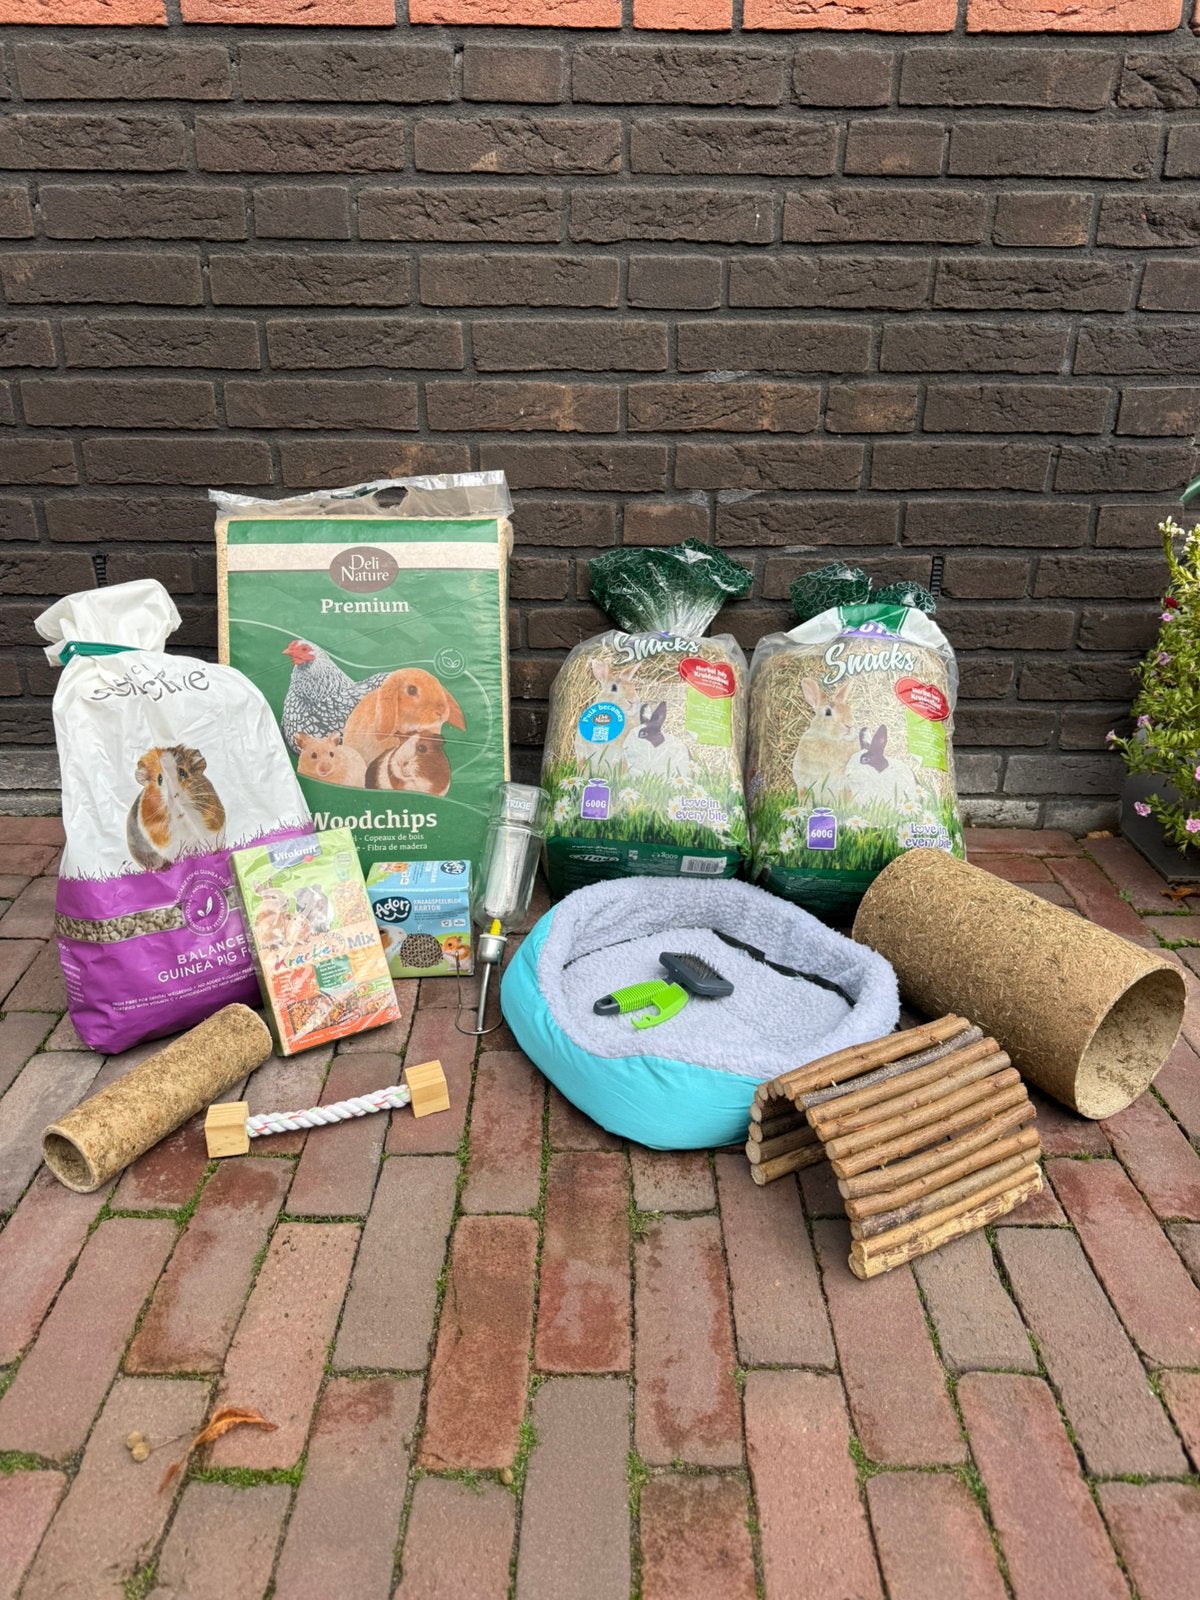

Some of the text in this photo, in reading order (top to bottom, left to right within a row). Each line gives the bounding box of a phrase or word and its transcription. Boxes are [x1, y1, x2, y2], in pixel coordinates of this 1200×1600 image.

[348, 554, 379, 570] Deli
[341, 566, 389, 582] Nature
[320, 598, 409, 614] Premium
[613, 631, 700, 665] Snacks
[823, 643, 915, 685] Snacks
[506, 799, 533, 811] TRIXIE
[585, 799, 607, 809] 600G
[709, 799, 719, 809] in
[311, 808, 438, 834] Woodchips
[676, 808, 727, 823] every bite
[364, 834, 396, 843] Copeaux
[398, 833, 407, 841] de
[408, 833, 425, 841] bois
[811, 828, 833, 840] 600G
[273, 844, 318, 862] Vitakraft
[367, 844, 387, 852] Fibra
[388, 843, 398, 851] de
[400, 843, 428, 851] madera
[413, 904, 441, 912] KARTON
[348, 932, 377, 949] Mix
[158, 960, 214, 983] GUINEA
[217, 951, 237, 966] PIG
